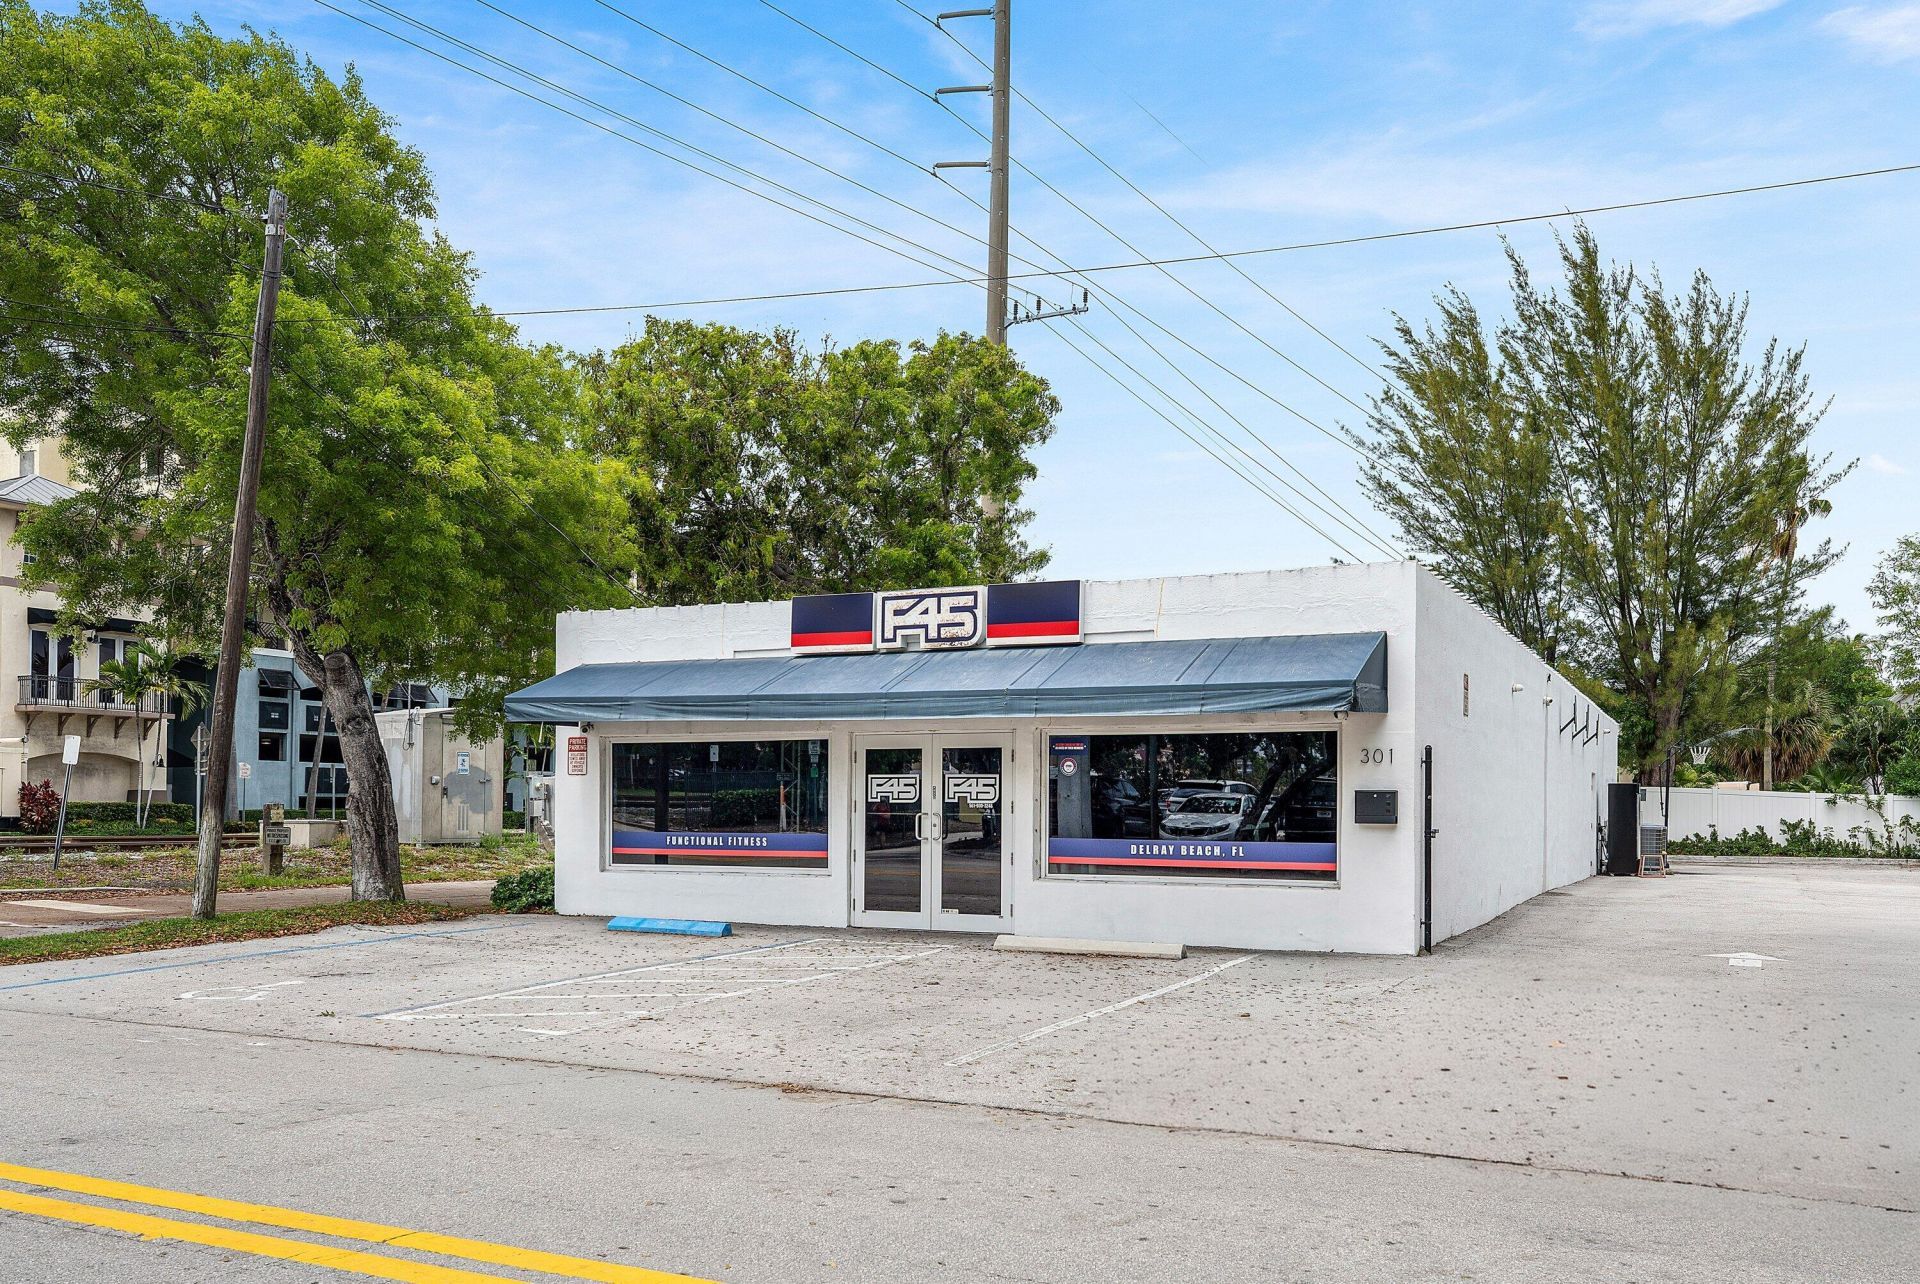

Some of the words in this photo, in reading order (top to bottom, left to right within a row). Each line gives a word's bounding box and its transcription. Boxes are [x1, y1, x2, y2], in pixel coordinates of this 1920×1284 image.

[881, 591, 978, 643] F45
[1360, 748, 1393, 765] 301
[869, 775, 919, 802] F45
[946, 775, 999, 802] F45
[666, 836, 723, 846] FUNCTIONAL
[728, 836, 768, 847] FITNESS
[1130, 844, 1175, 855] DELRAY
[1180, 845, 1226, 857] BEACH,
[1231, 846, 1245, 857] FL
